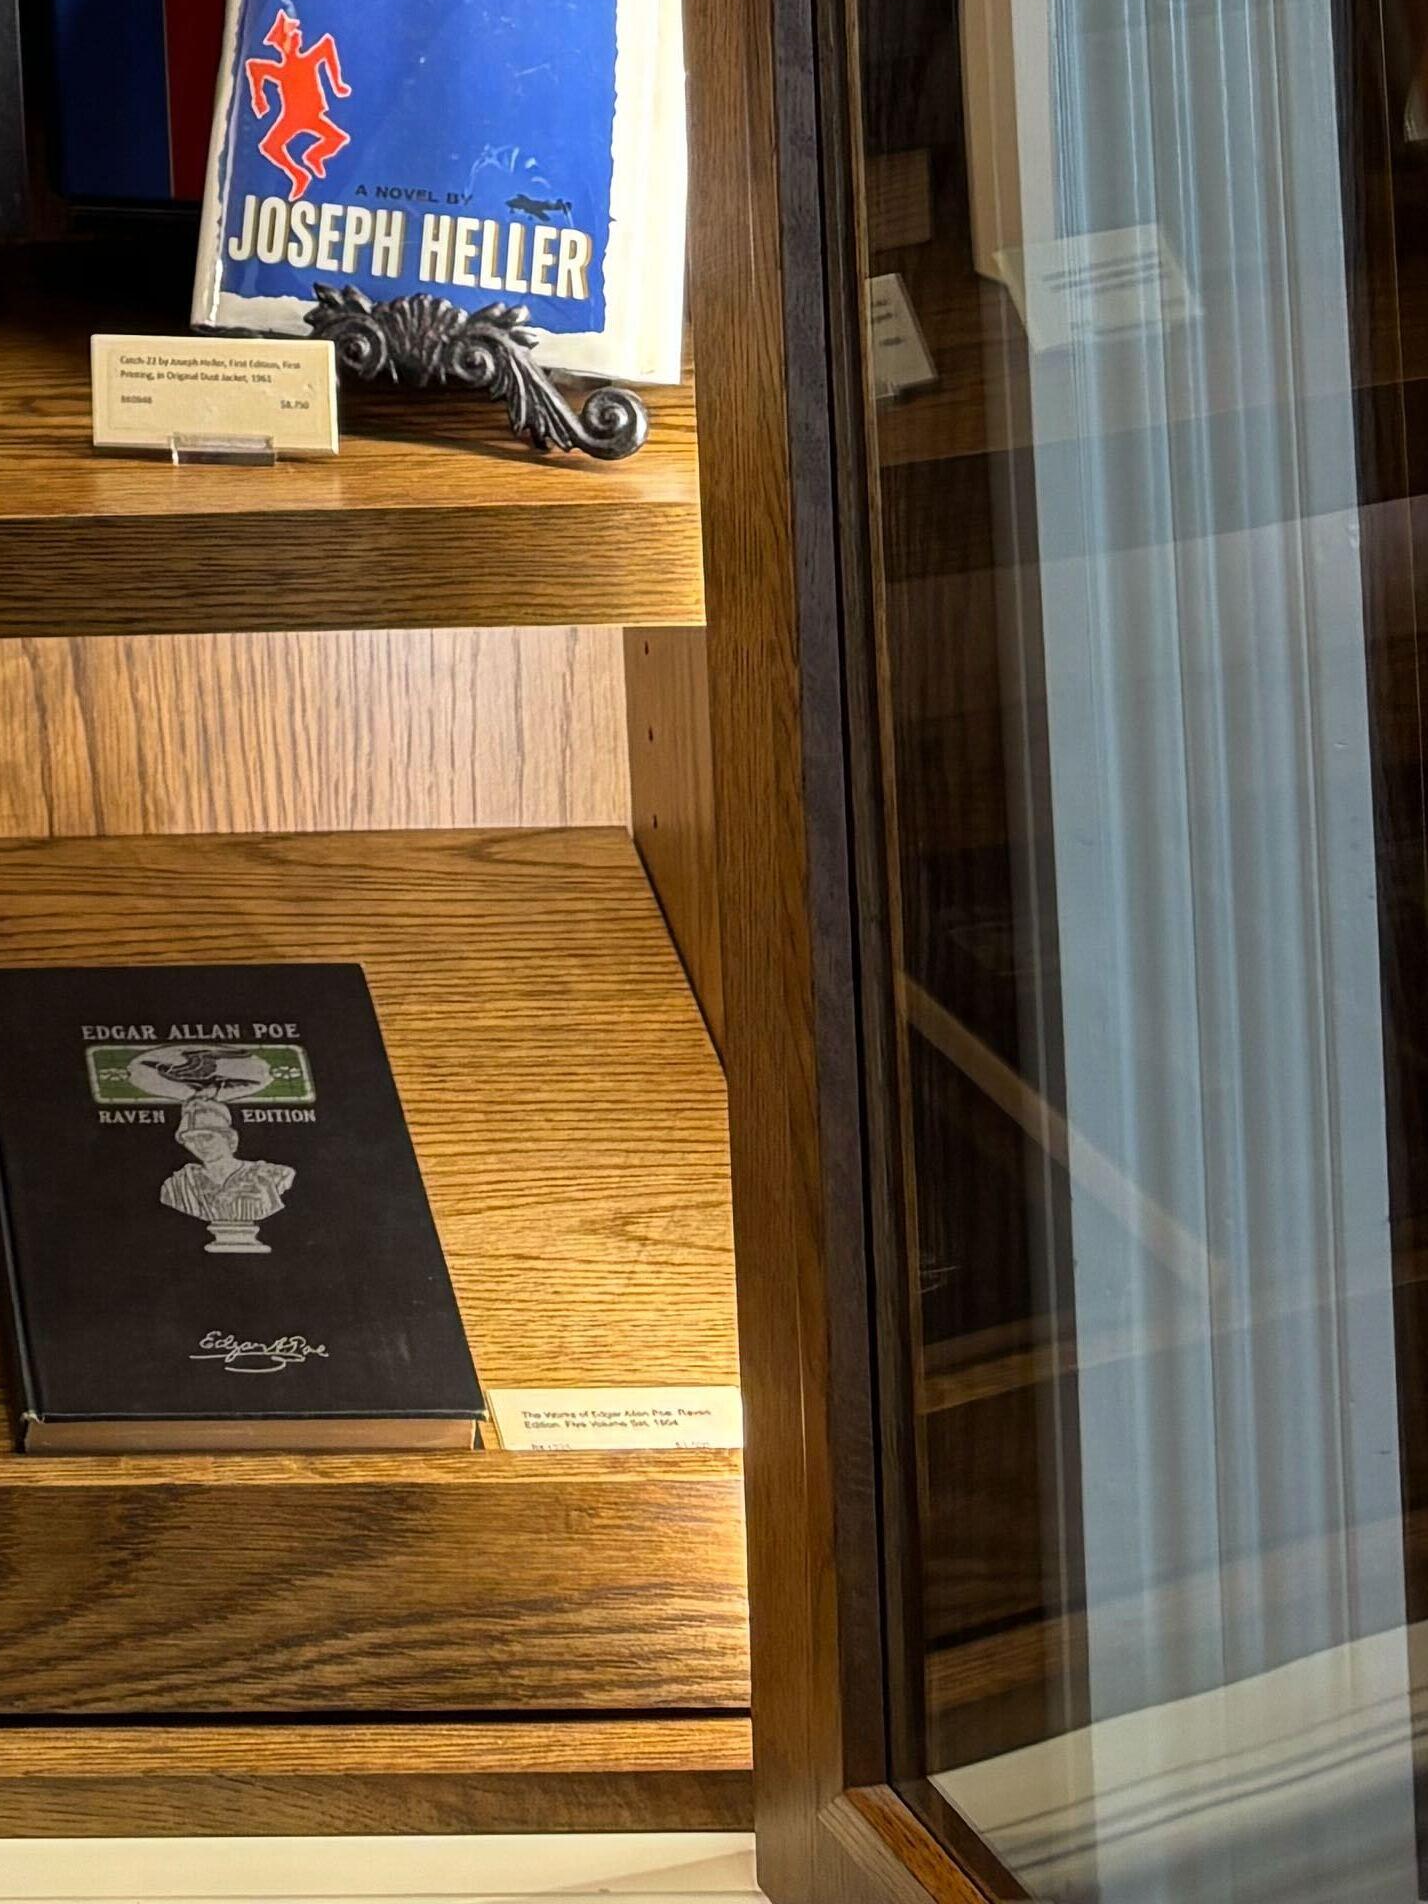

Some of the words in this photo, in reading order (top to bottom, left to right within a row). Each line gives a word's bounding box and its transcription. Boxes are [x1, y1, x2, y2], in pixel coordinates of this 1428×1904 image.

[354, 185, 369, 197] A
[377, 186, 440, 202] NOVEL
[448, 192, 474, 206] BY
[229, 200, 404, 279] JOSEPH
[418, 218, 592, 299] HELLER
[82, 1025, 157, 1040] EDGAR
[168, 1024, 240, 1039] ALLAN
[253, 1024, 299, 1038] POE
[99, 1110, 165, 1124] RAVEN
[243, 1109, 316, 1124] EDITION
